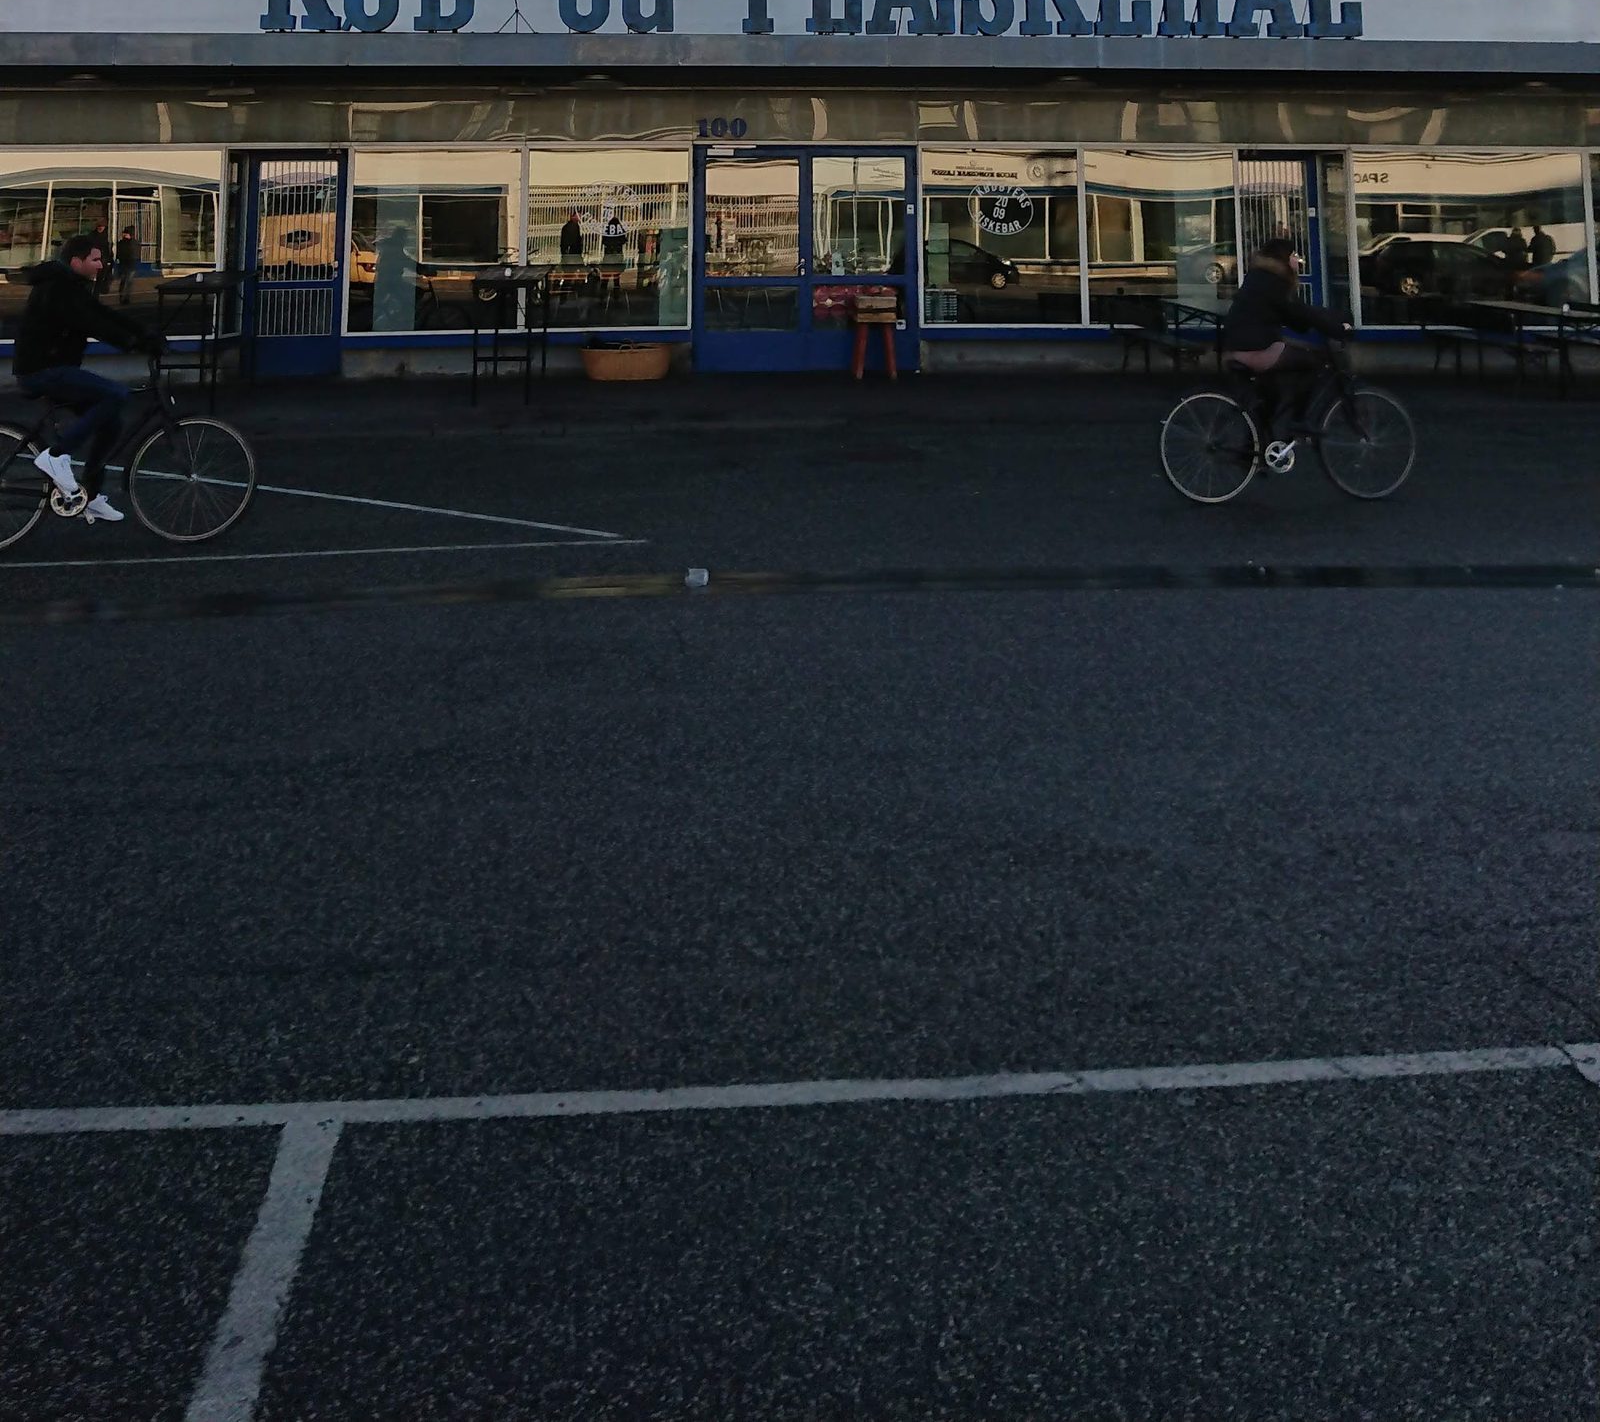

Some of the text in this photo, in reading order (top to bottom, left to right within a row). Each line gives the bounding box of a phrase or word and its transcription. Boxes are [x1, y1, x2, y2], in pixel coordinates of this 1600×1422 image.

[697, 117, 747, 138] 100
[995, 196, 1008, 208] 20
[993, 207, 1006, 220] 09
